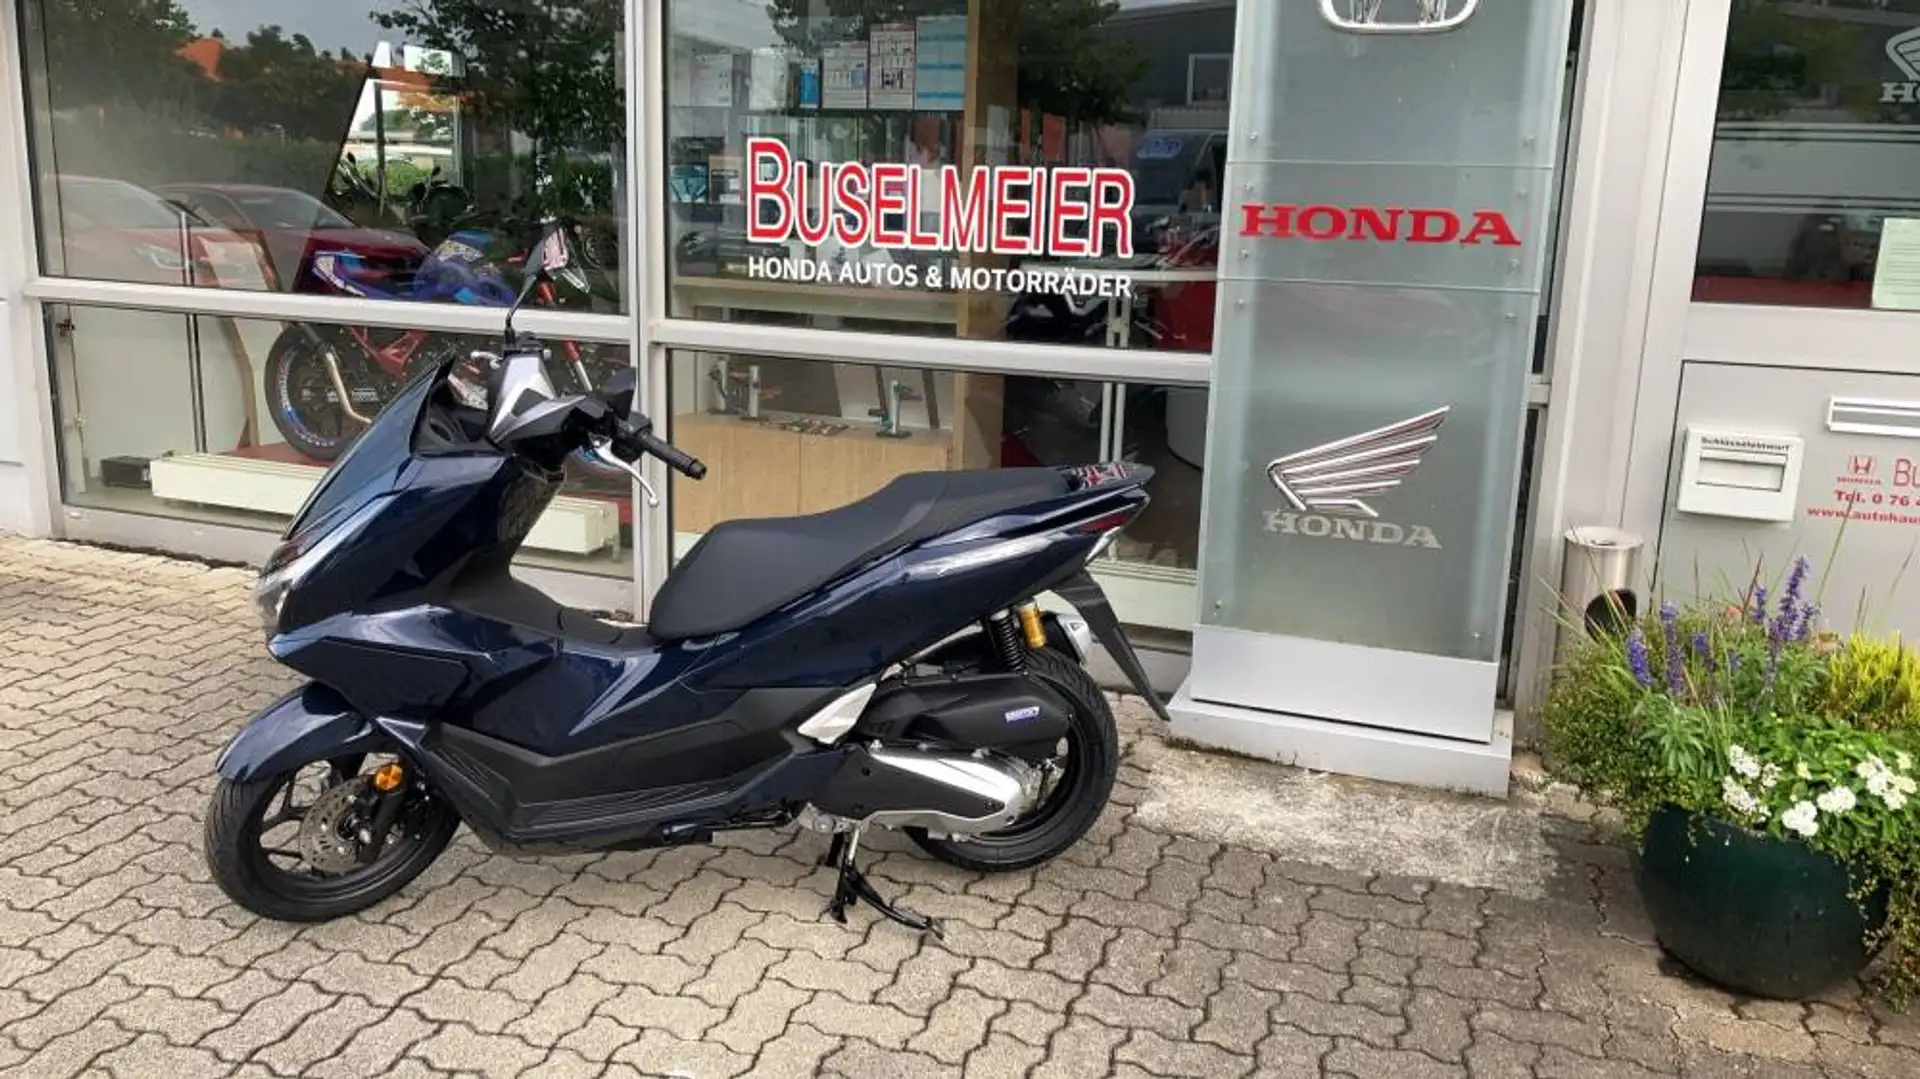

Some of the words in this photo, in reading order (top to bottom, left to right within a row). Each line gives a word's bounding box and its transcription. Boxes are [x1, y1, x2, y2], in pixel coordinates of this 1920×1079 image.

[746, 137, 1135, 259] BUSELMEIER
[1240, 204, 1522, 246] HONDA
[748, 256, 832, 282] HONDA
[839, 264, 920, 287] AUTOS
[925, 267, 943, 289] &
[950, 266, 1134, 298] MOTORRÄDER
[1872, 494, 1883, 504] 0
[1890, 495, 1910, 506] 76
[1262, 510, 1443, 549] HONDA
